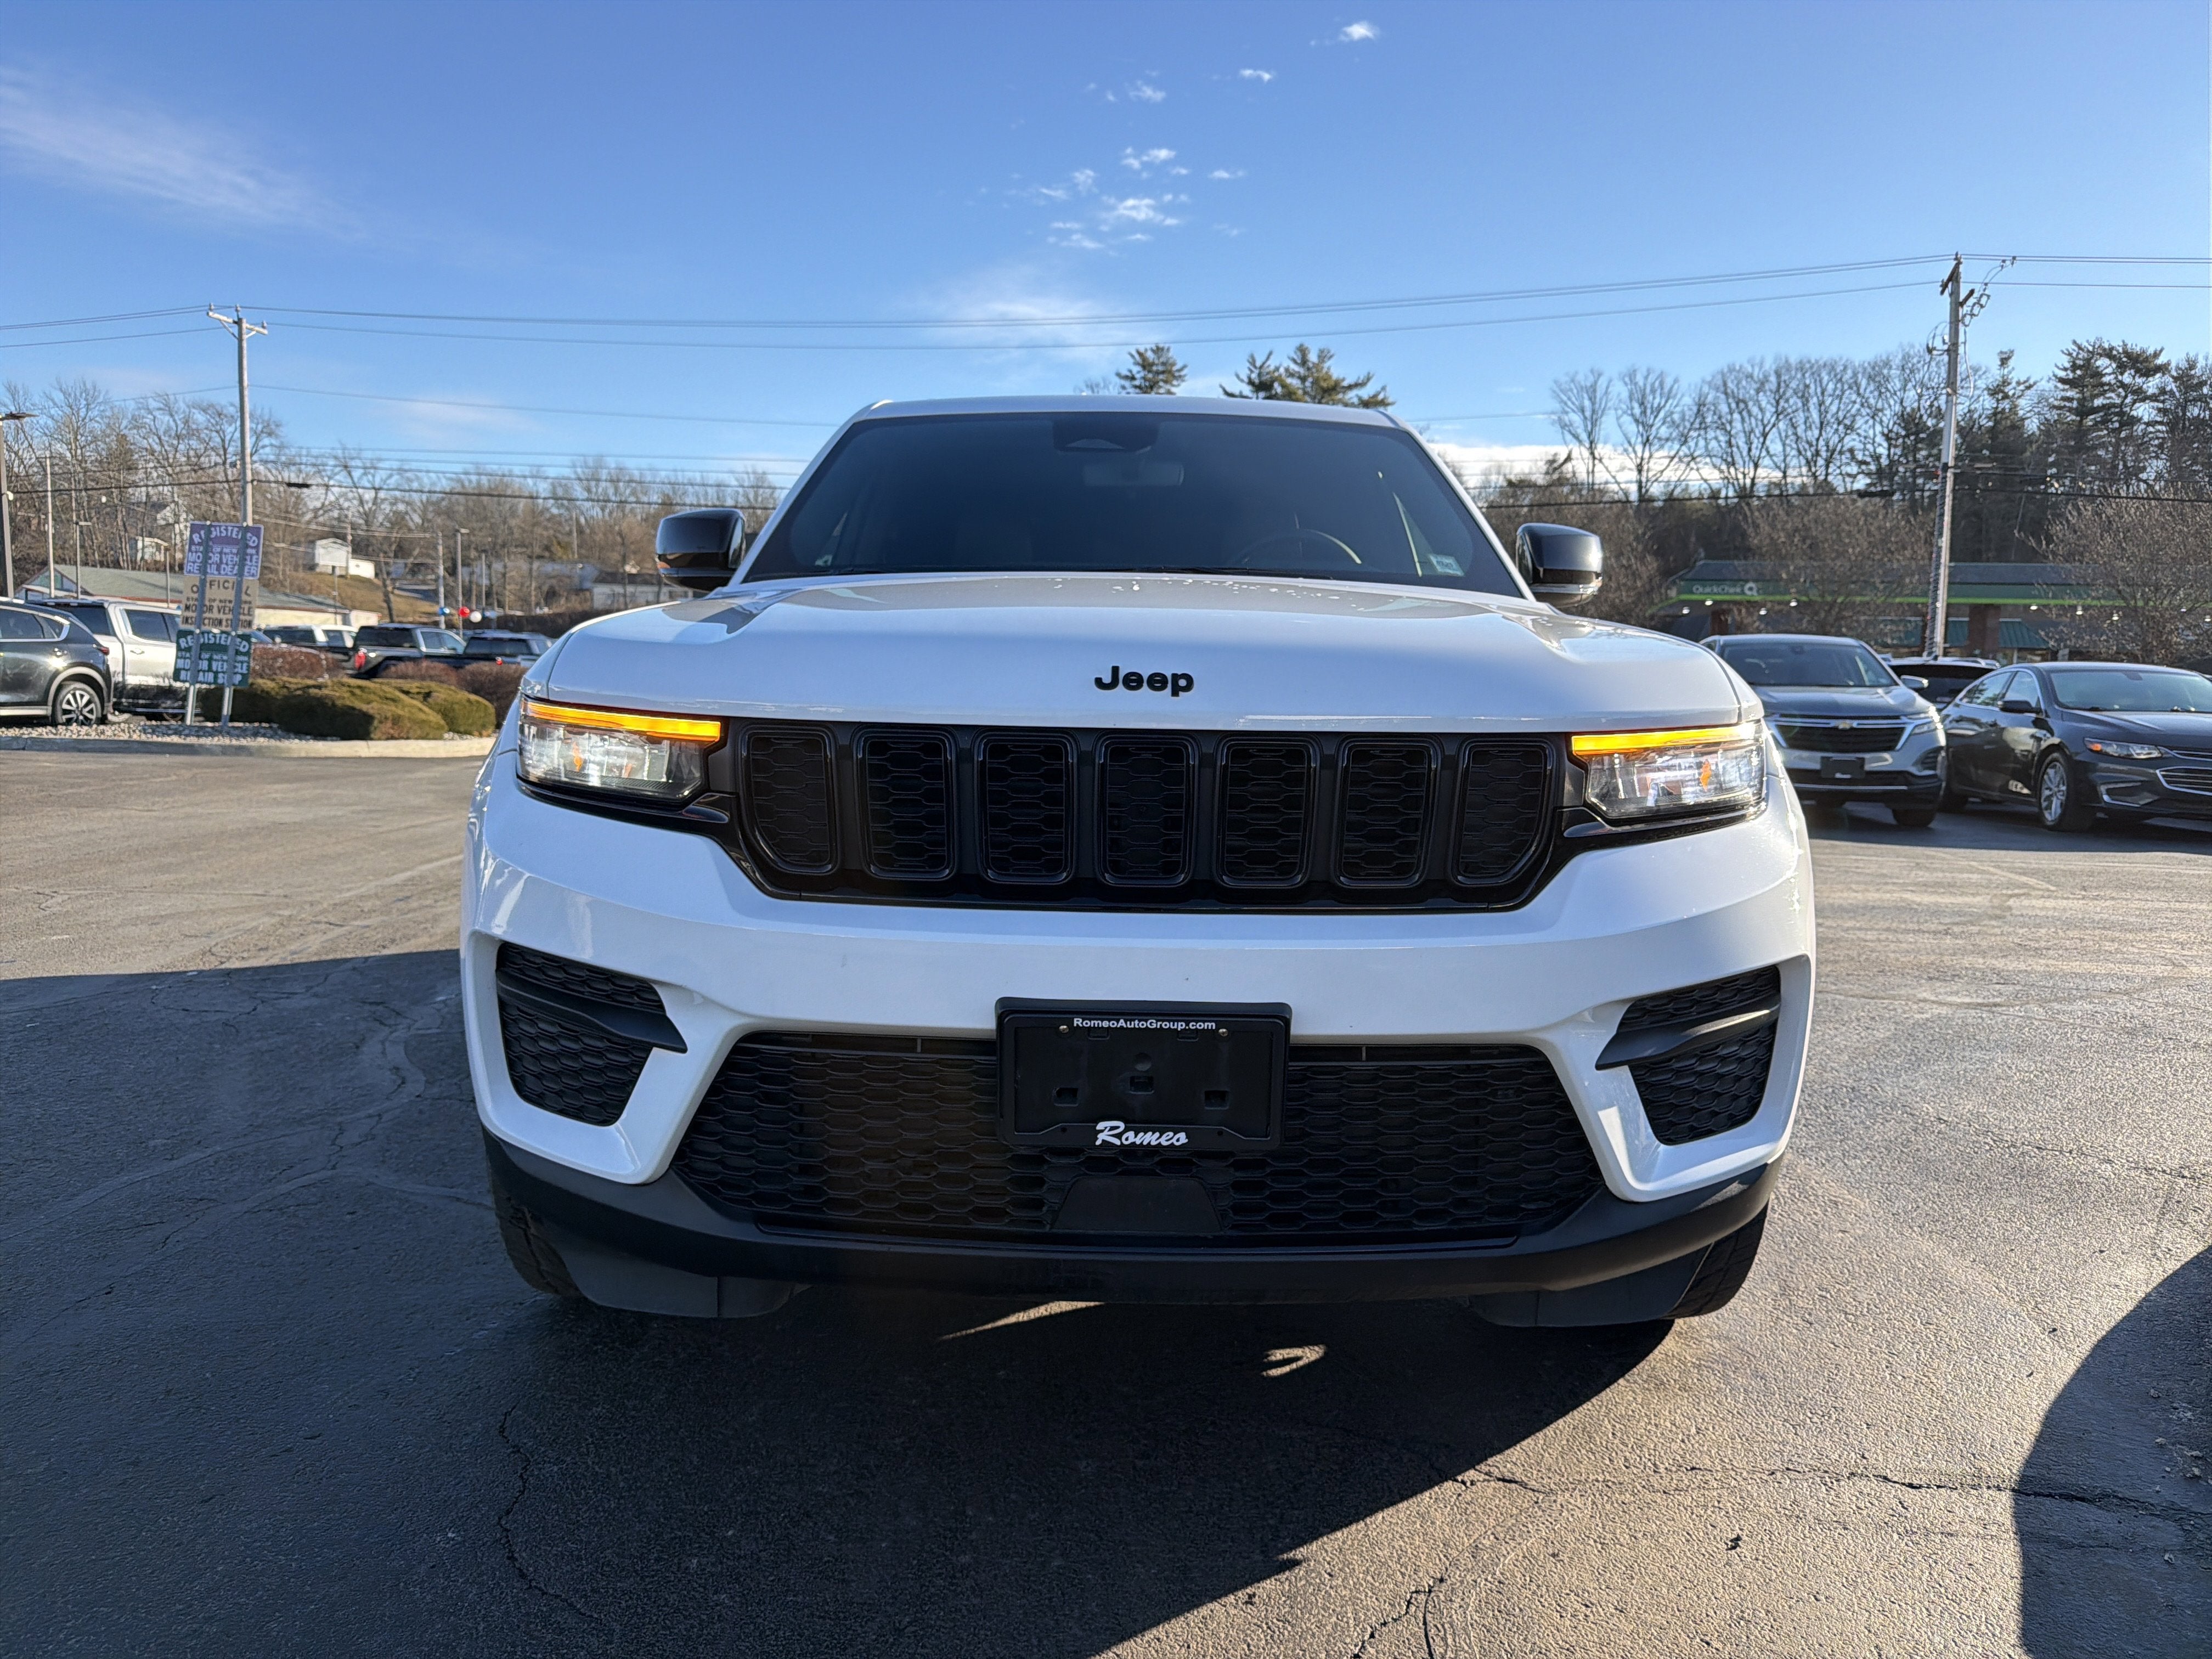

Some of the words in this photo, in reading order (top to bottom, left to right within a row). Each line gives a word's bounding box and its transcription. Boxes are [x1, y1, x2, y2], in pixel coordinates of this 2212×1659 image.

[188, 552, 219, 564] MOOR
[191, 579, 251, 597] OFICIL
[184, 603, 214, 614] MOOR
[182, 616, 223, 627] INSCTION
[1094, 666, 1194, 697] Jeep
[1074, 1018, 1216, 1030] RomeoAutoGroup.com
[1096, 1121, 1189, 1146] Romeo
